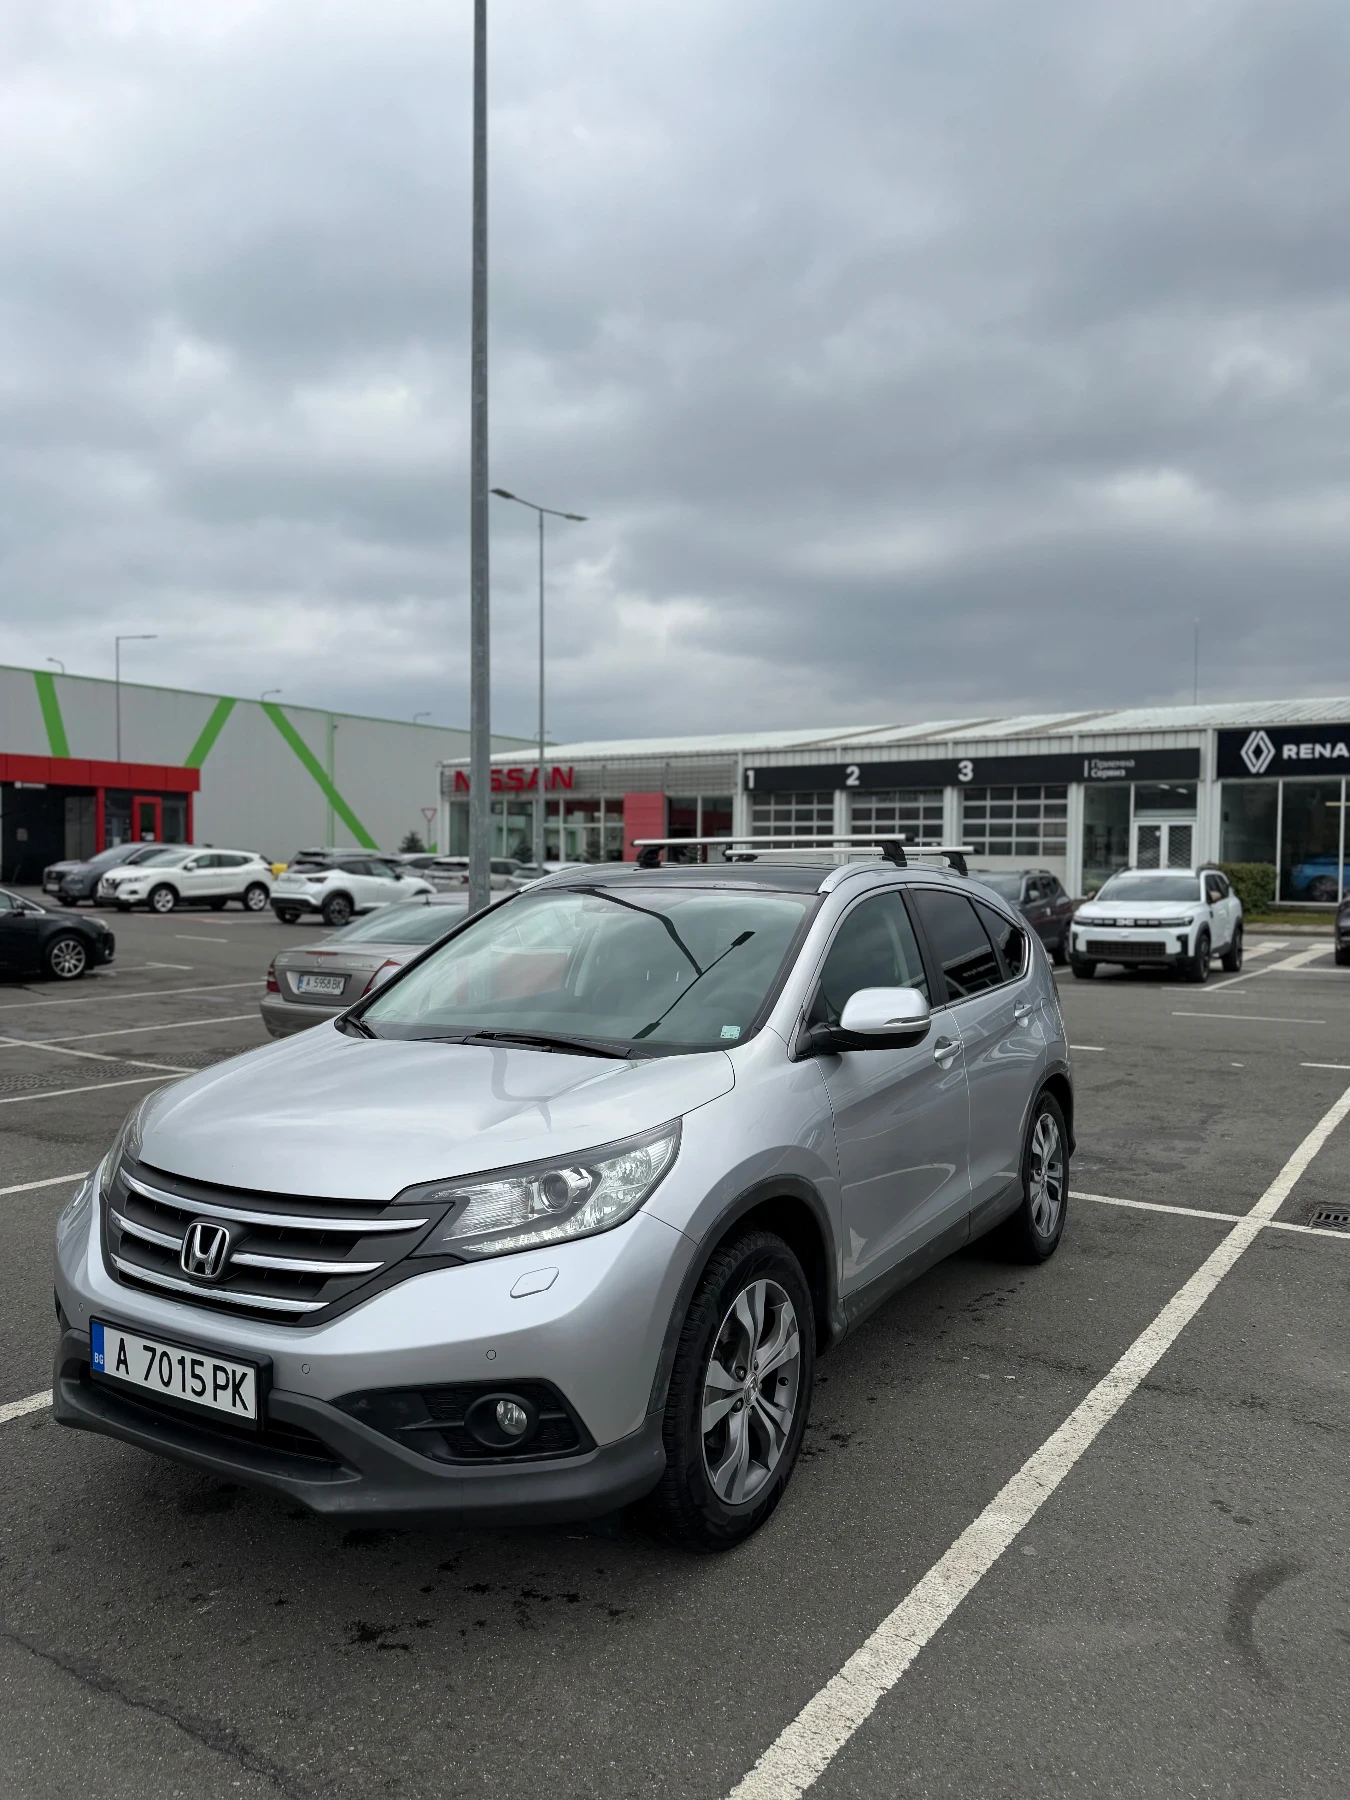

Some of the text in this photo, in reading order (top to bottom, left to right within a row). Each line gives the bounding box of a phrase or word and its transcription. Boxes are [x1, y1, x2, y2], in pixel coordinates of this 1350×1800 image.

[454, 766, 574, 793] NSSAN
[746, 769, 755, 789] 1
[845, 765, 861, 786] 2
[957, 760, 974, 783] 3
[94, 1351, 104, 1365] BG
[116, 1337, 130, 1375] A
